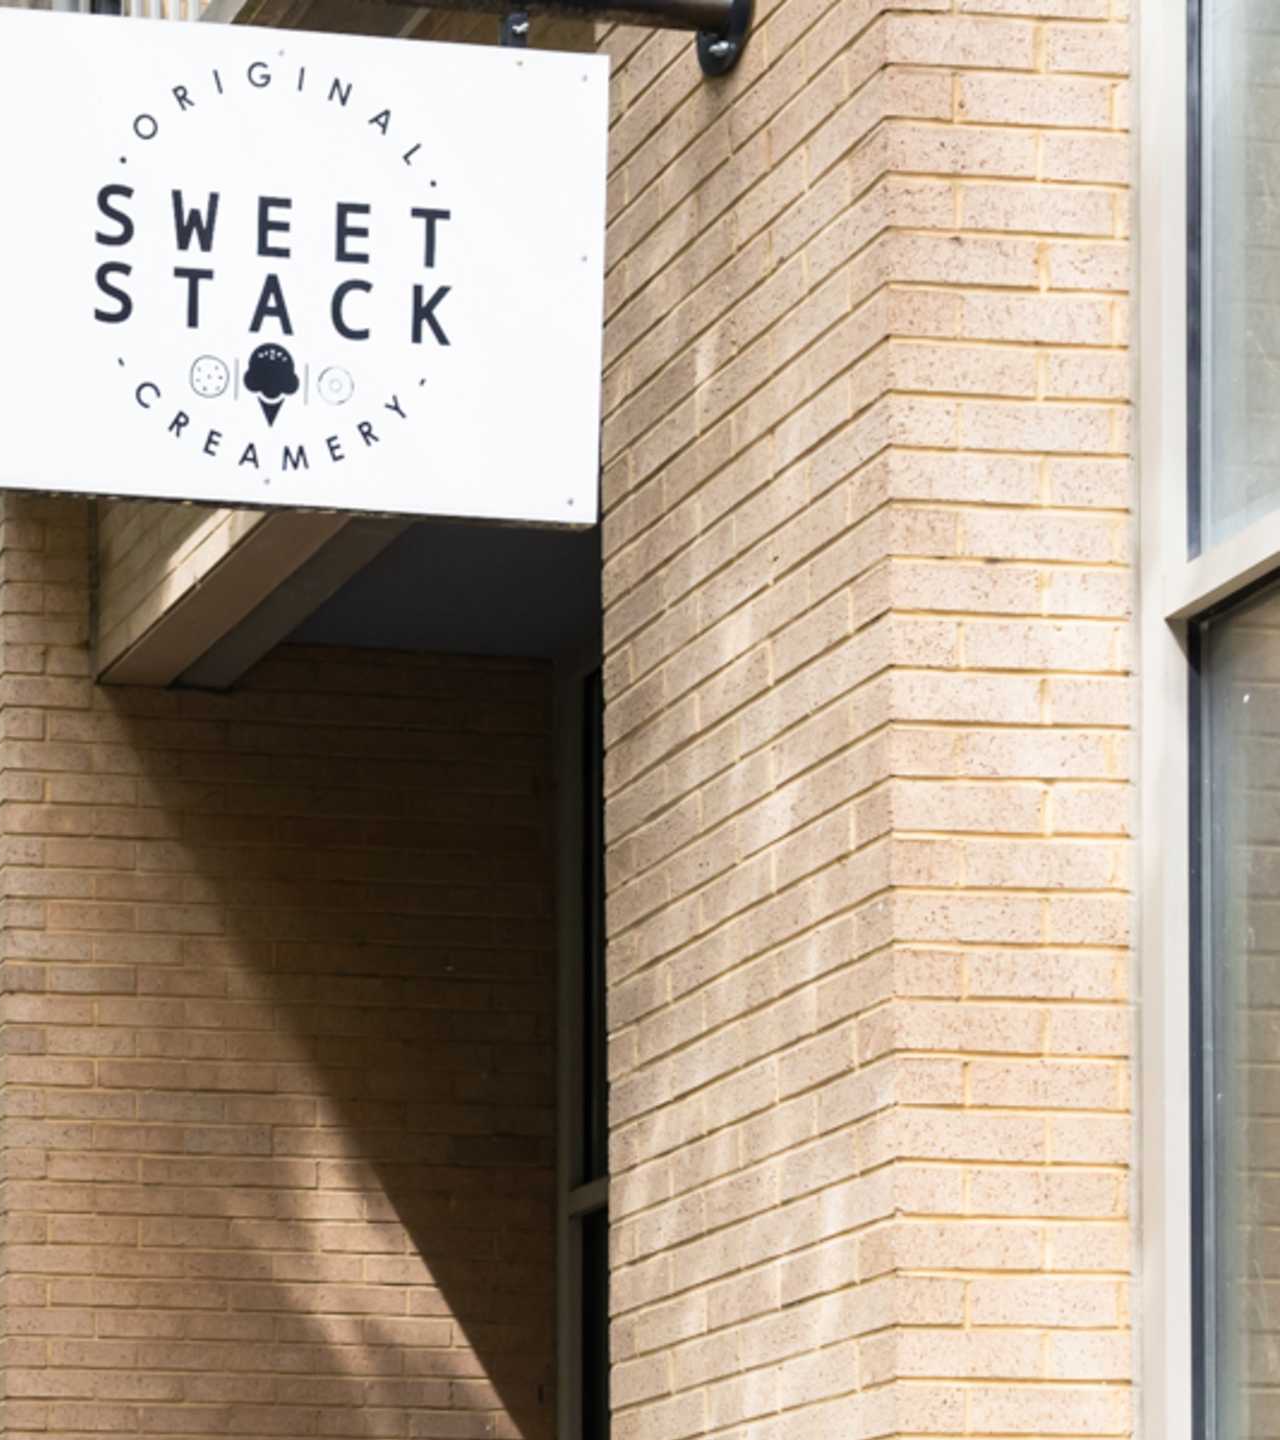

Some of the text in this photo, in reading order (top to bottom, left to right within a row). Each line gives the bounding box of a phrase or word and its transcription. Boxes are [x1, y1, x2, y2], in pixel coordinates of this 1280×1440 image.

[133, 62, 422, 166] ORIGINAL
[95, 184, 451, 268] SWEET
[94, 261, 451, 346] STACK
[135, 382, 407, 470] CREAMERY
